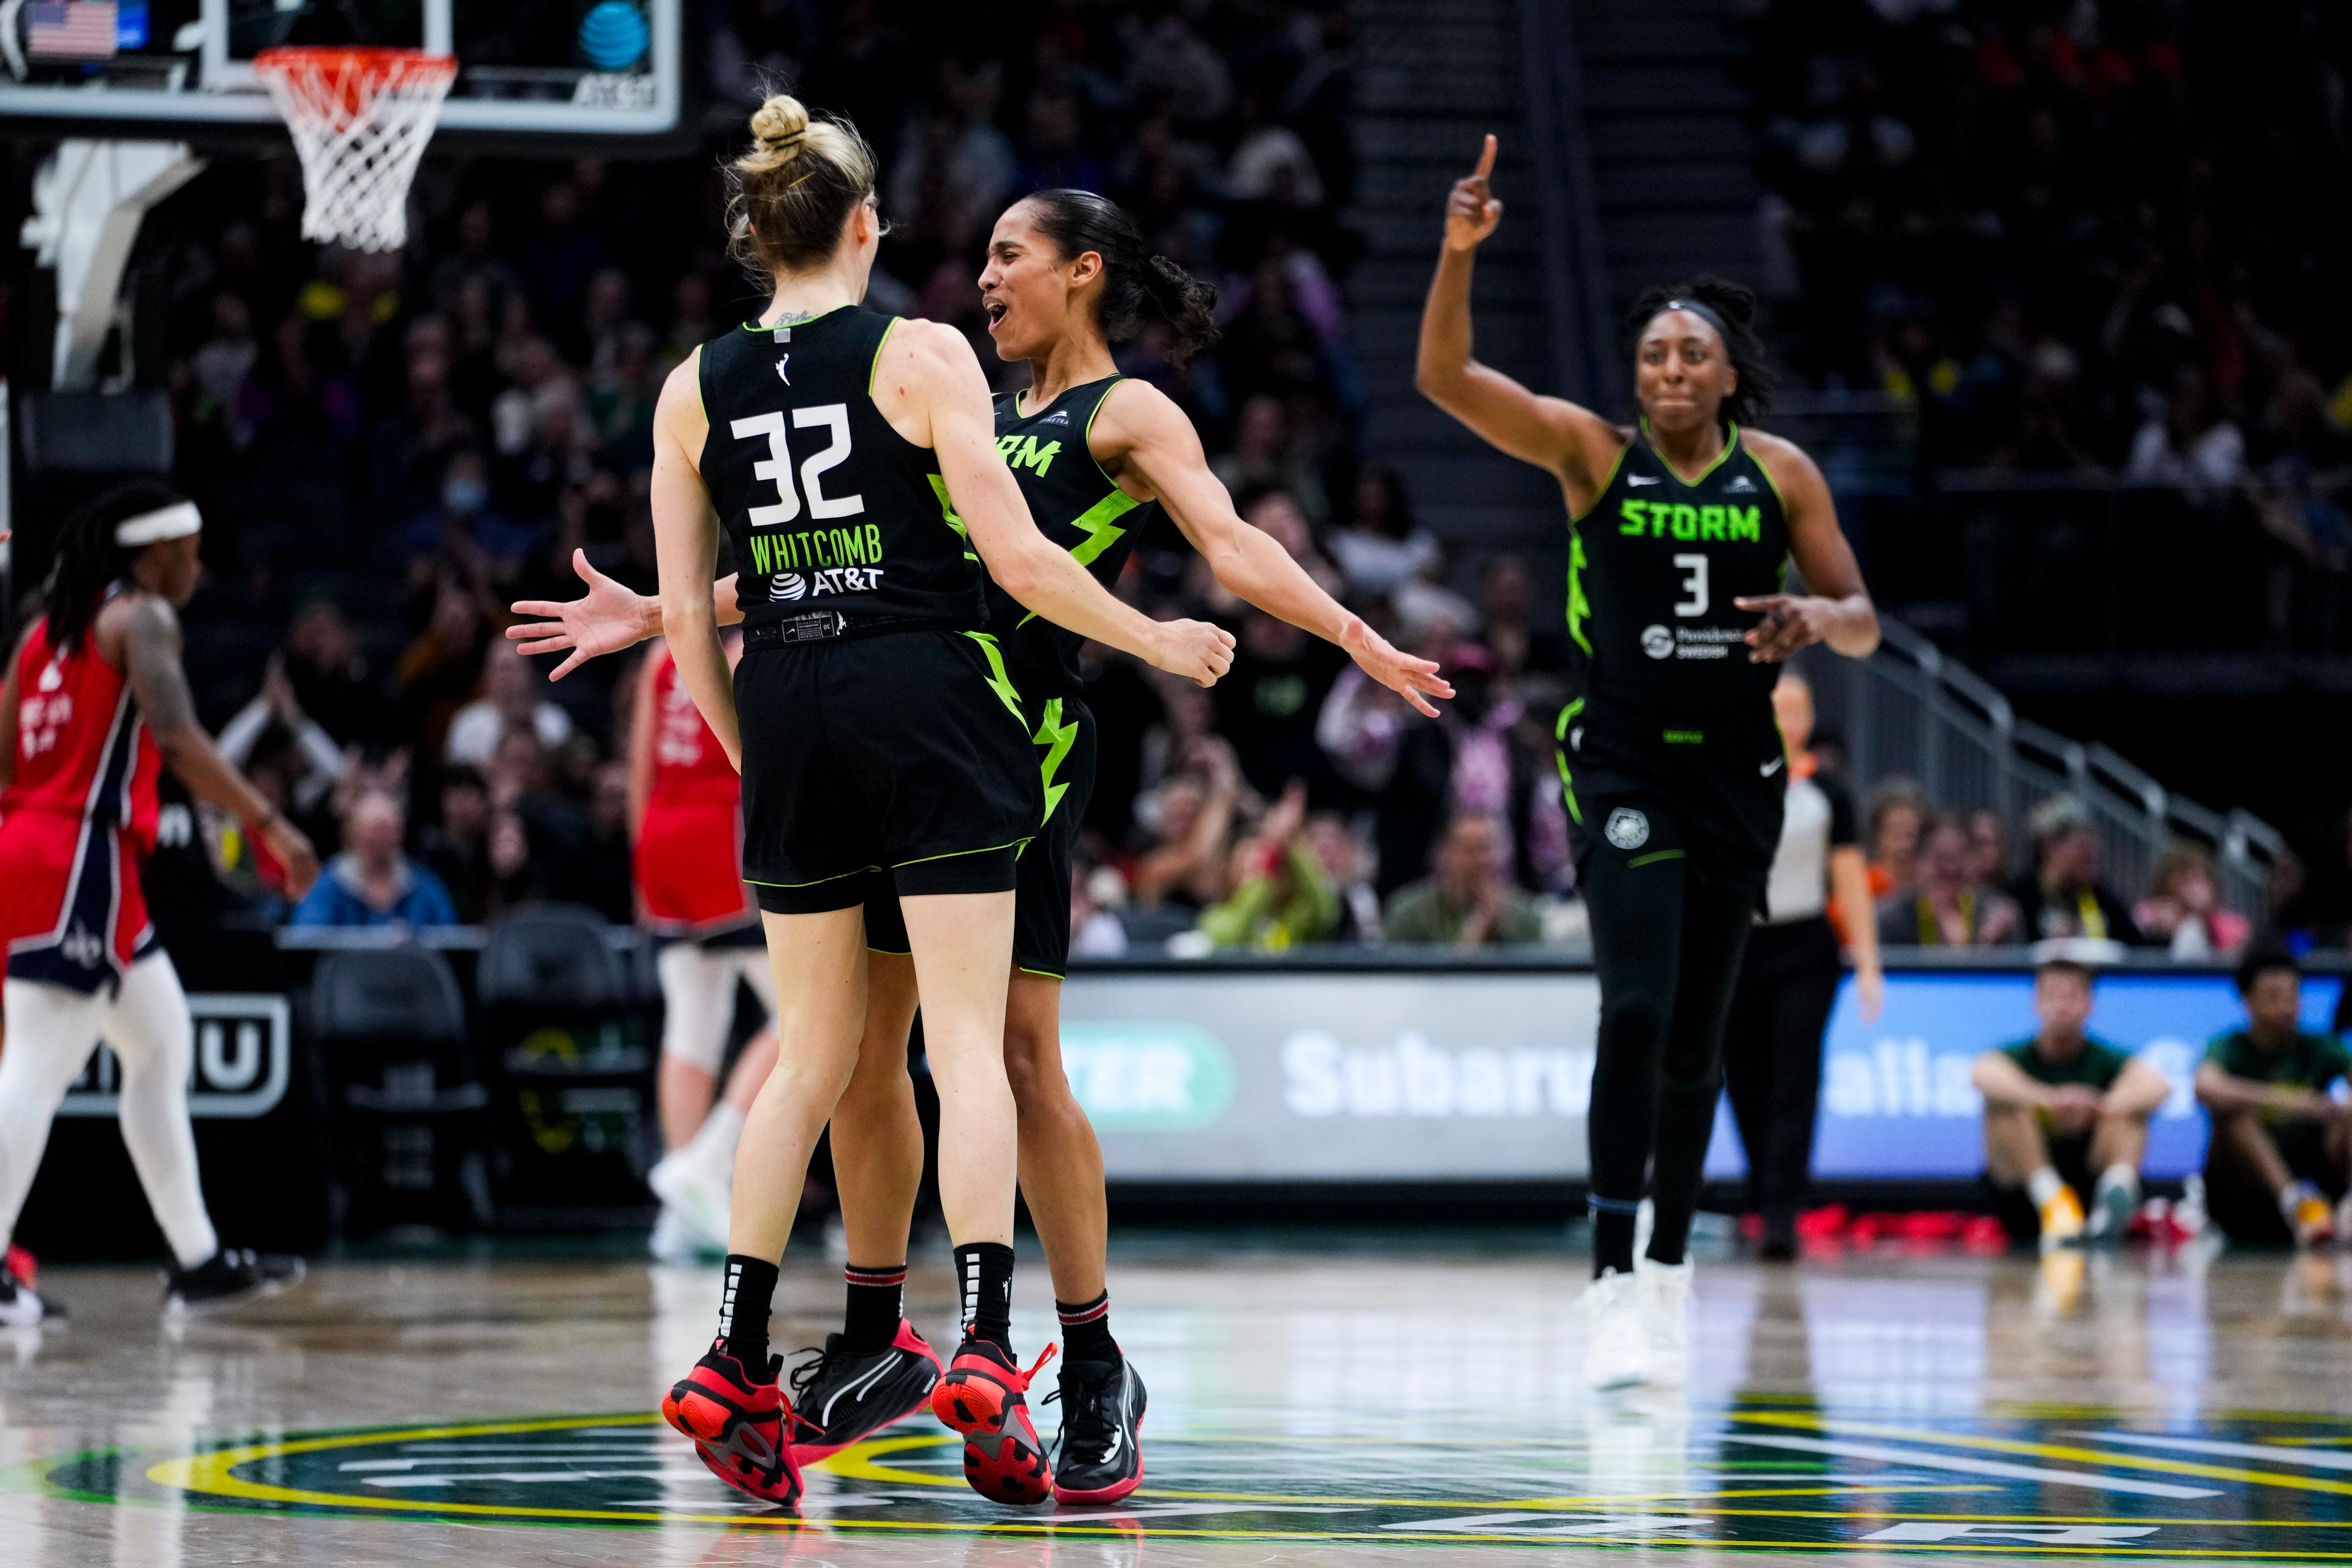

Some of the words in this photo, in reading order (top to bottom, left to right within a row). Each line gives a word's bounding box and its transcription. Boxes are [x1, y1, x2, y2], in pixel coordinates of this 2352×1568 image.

[729, 402, 865, 527] 32
[995, 435, 1062, 478] RM
[1619, 499, 1762, 543] STORM
[750, 524, 883, 575] WHITCOMB
[812, 567, 884, 597] AT&T
[1673, 553, 1709, 617] 3
[1284, 1030, 1596, 1116] Subaru
